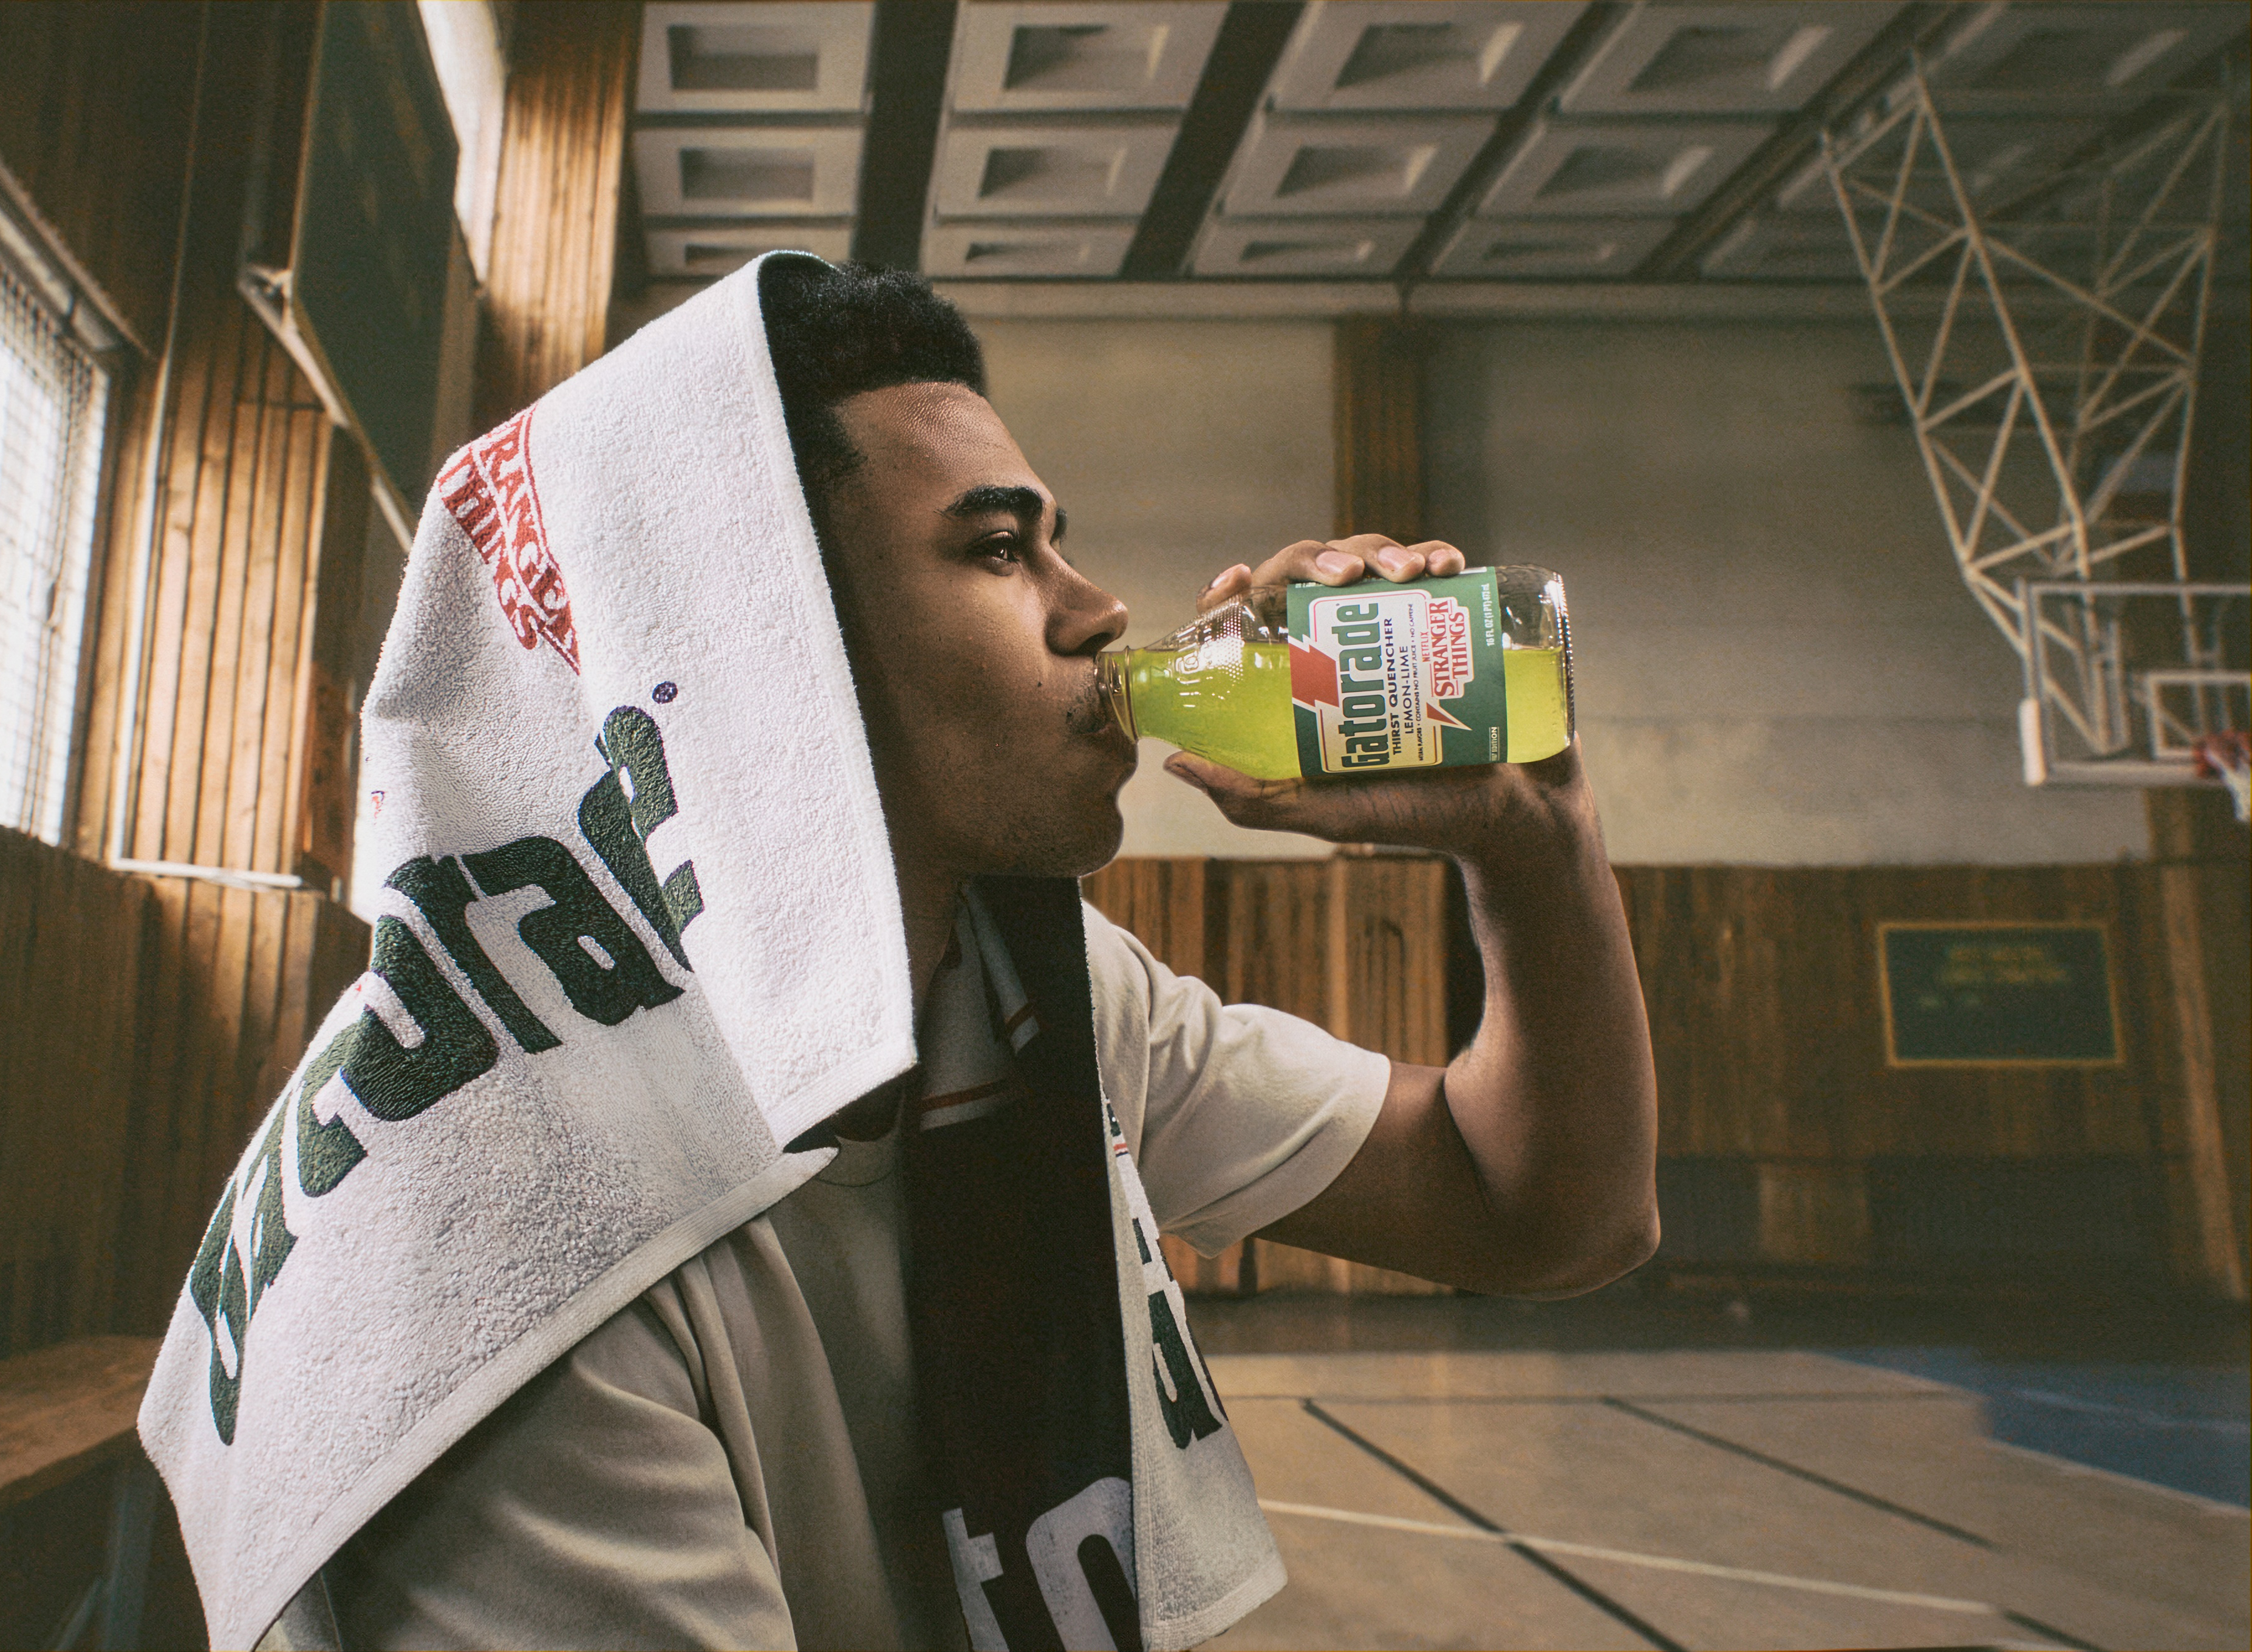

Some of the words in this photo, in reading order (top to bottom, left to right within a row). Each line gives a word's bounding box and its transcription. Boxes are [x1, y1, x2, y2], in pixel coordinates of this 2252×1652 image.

[1410, 628, 1415, 638] NO
[1484, 618, 1493, 628] OZ
[1486, 638, 1495, 646] 16
[1384, 618, 1398, 708] QUENCHER
[1420, 631, 1431, 662] NETFLIX
[1429, 599, 1455, 698] STRANGER
[1451, 612, 1469, 680] THINGS
[1331, 602, 1390, 768] Gatorade
[1399, 646, 1414, 734] LEMON-LIME
[1413, 680, 1419, 691] NO
[1390, 712, 1402, 756] THIRST
